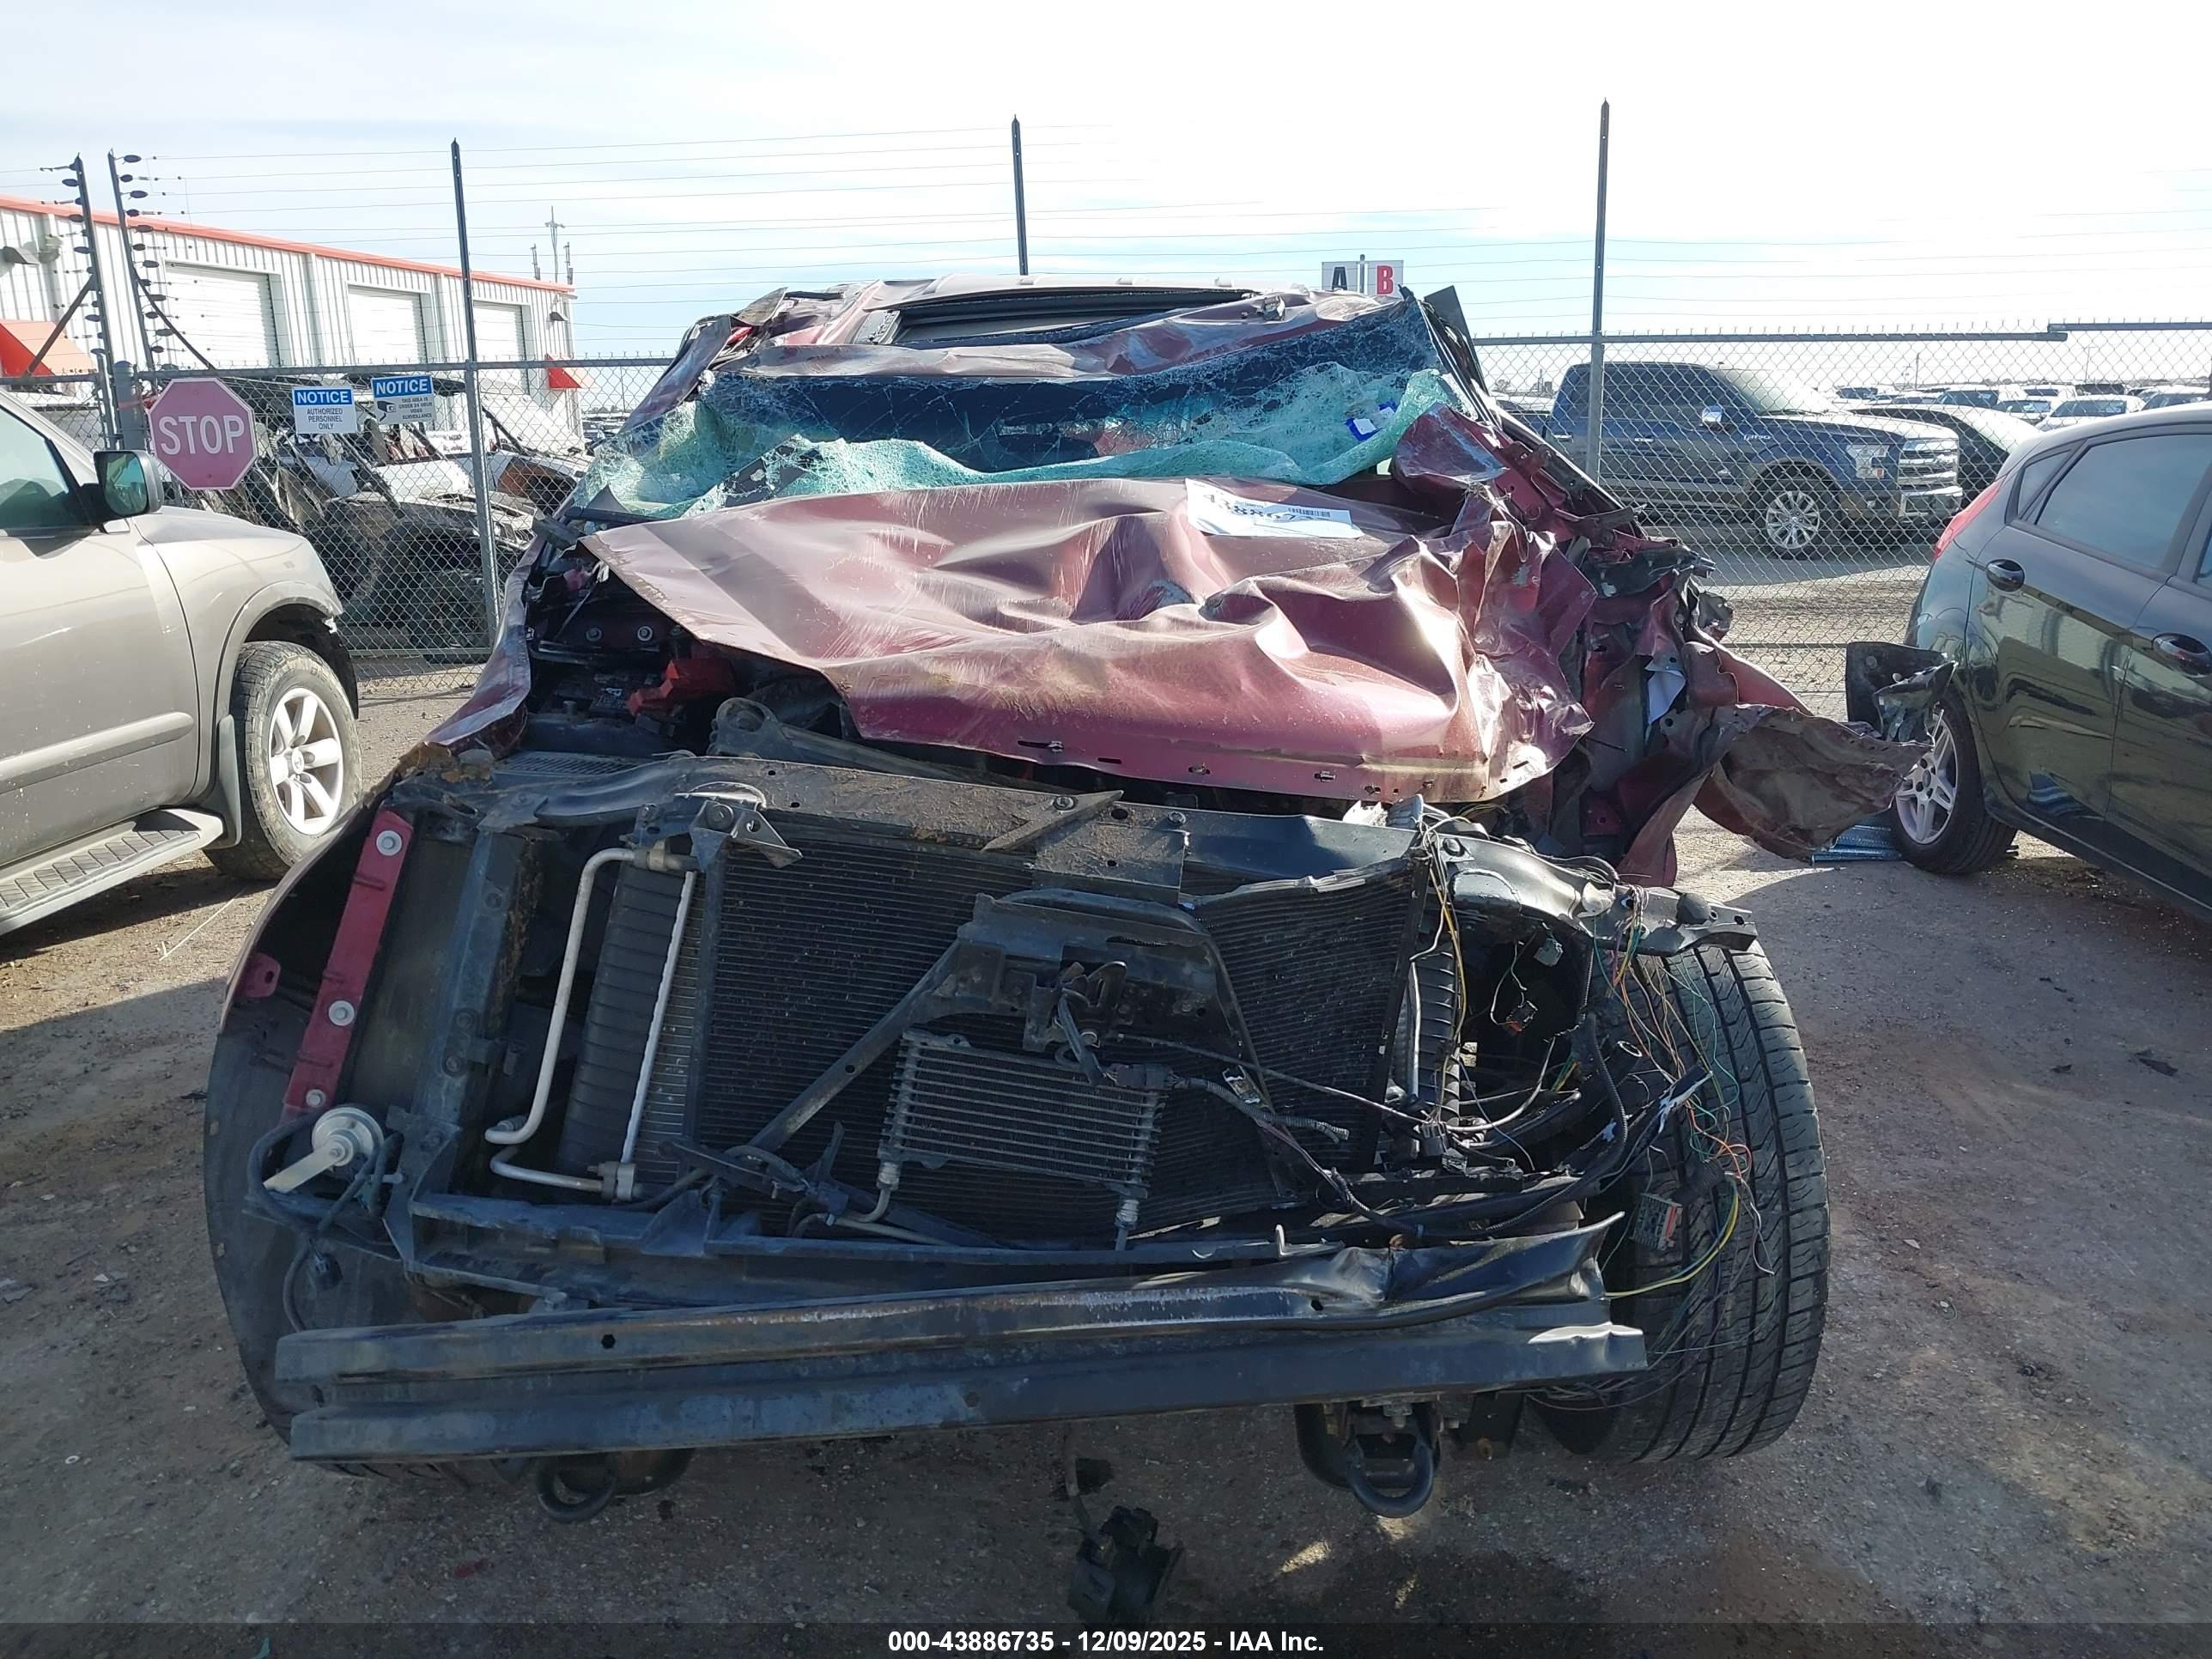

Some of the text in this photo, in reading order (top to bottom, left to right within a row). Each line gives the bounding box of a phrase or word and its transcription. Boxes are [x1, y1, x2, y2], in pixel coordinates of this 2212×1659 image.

[1332, 265, 1394, 295] A B
[297, 391, 349, 404] NOTICE
[376, 379, 428, 395] NOTICE
[159, 415, 245, 455] STOP
